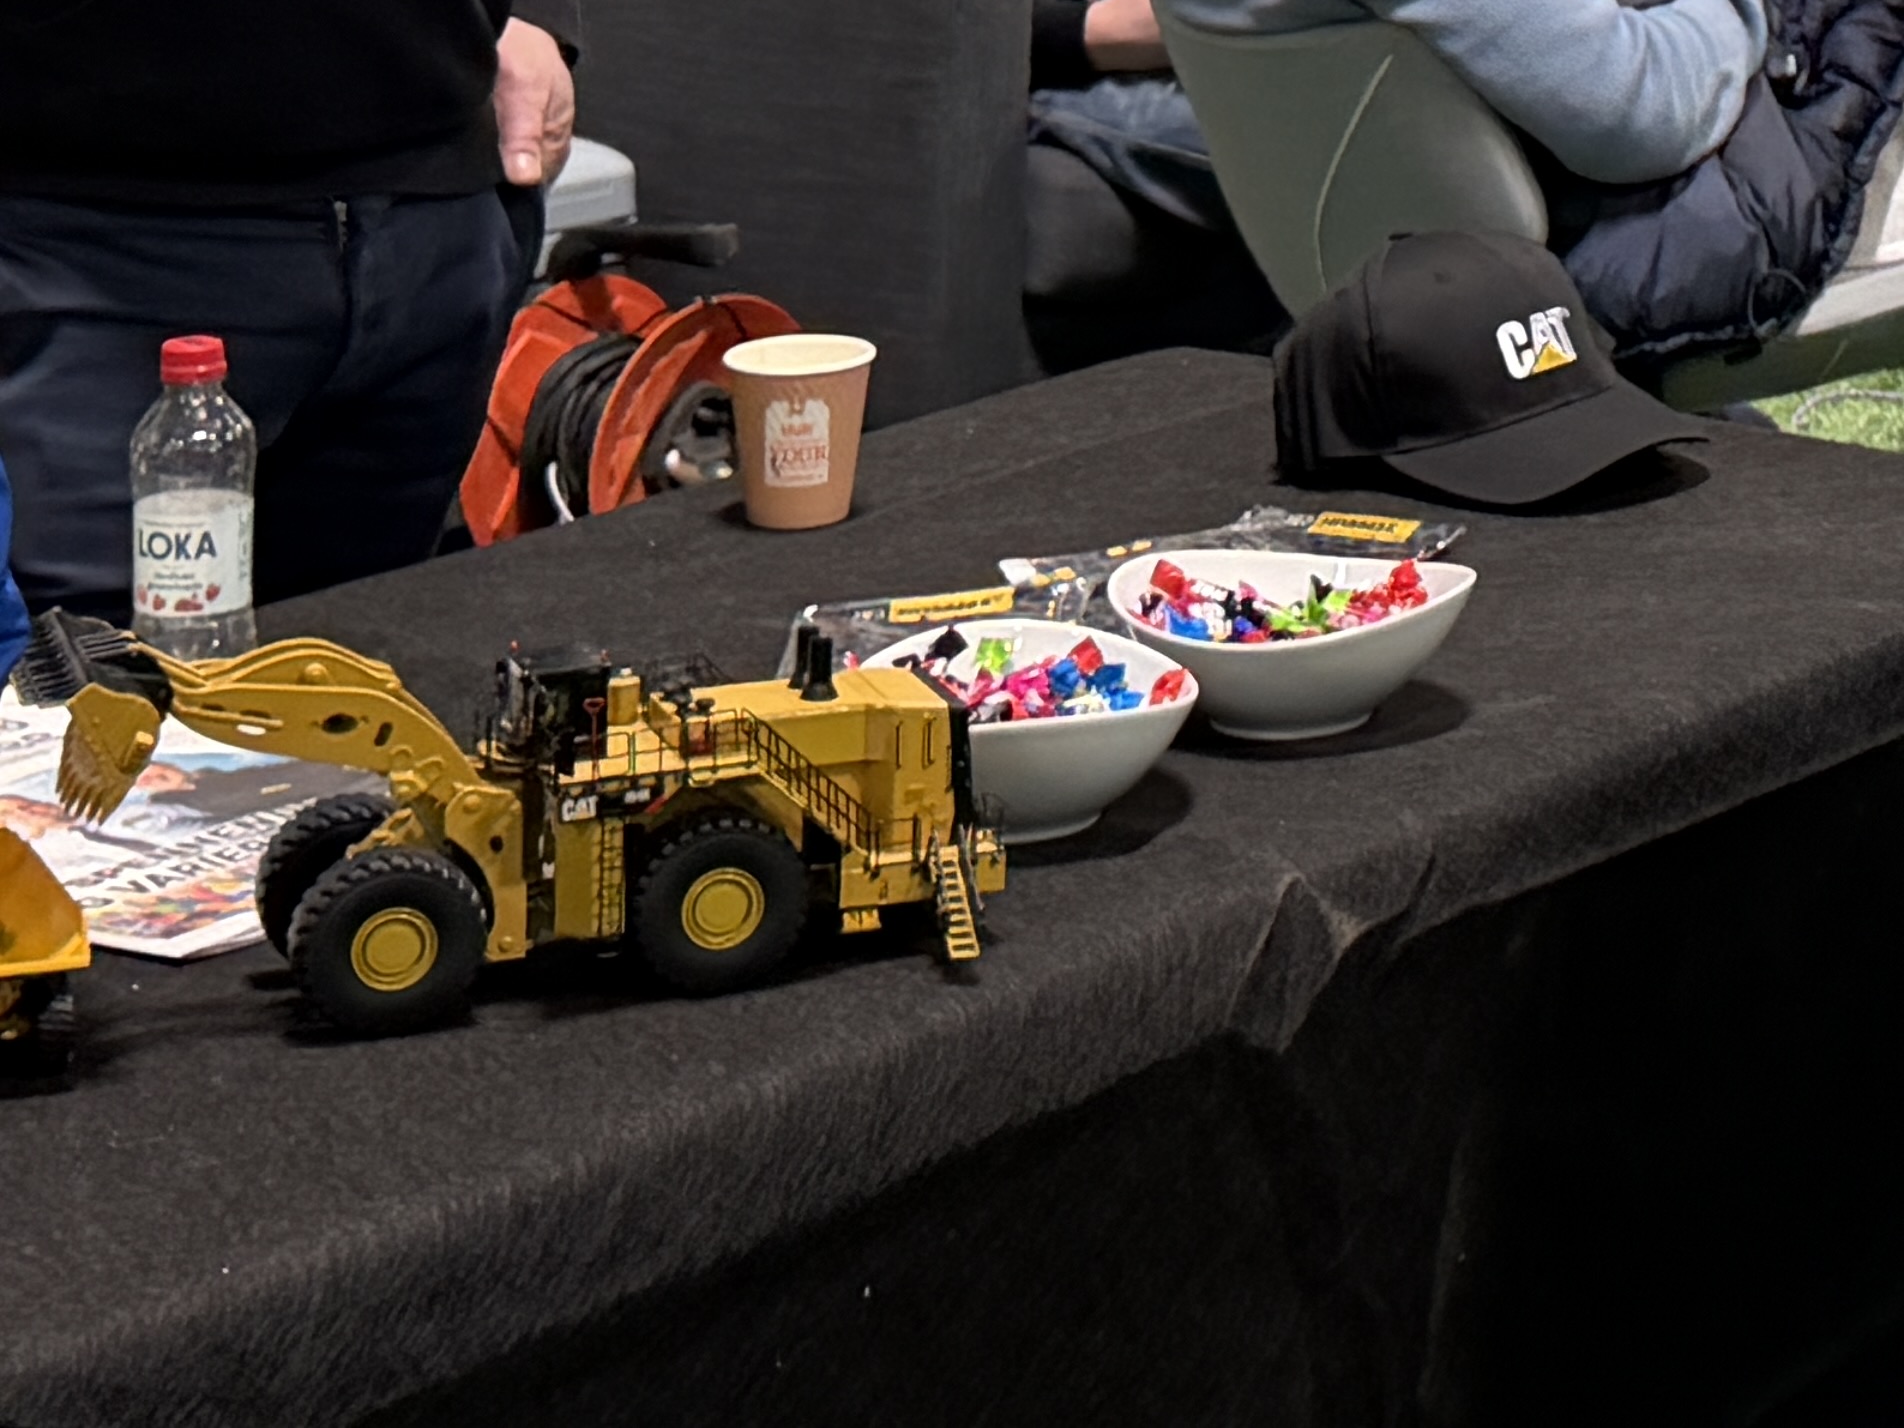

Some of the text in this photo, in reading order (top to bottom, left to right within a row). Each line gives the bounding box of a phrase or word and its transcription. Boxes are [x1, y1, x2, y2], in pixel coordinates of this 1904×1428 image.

[1495, 306, 1578, 380] CAT
[138, 528, 218, 561] LOKA
[561, 794, 599, 823] CAT
